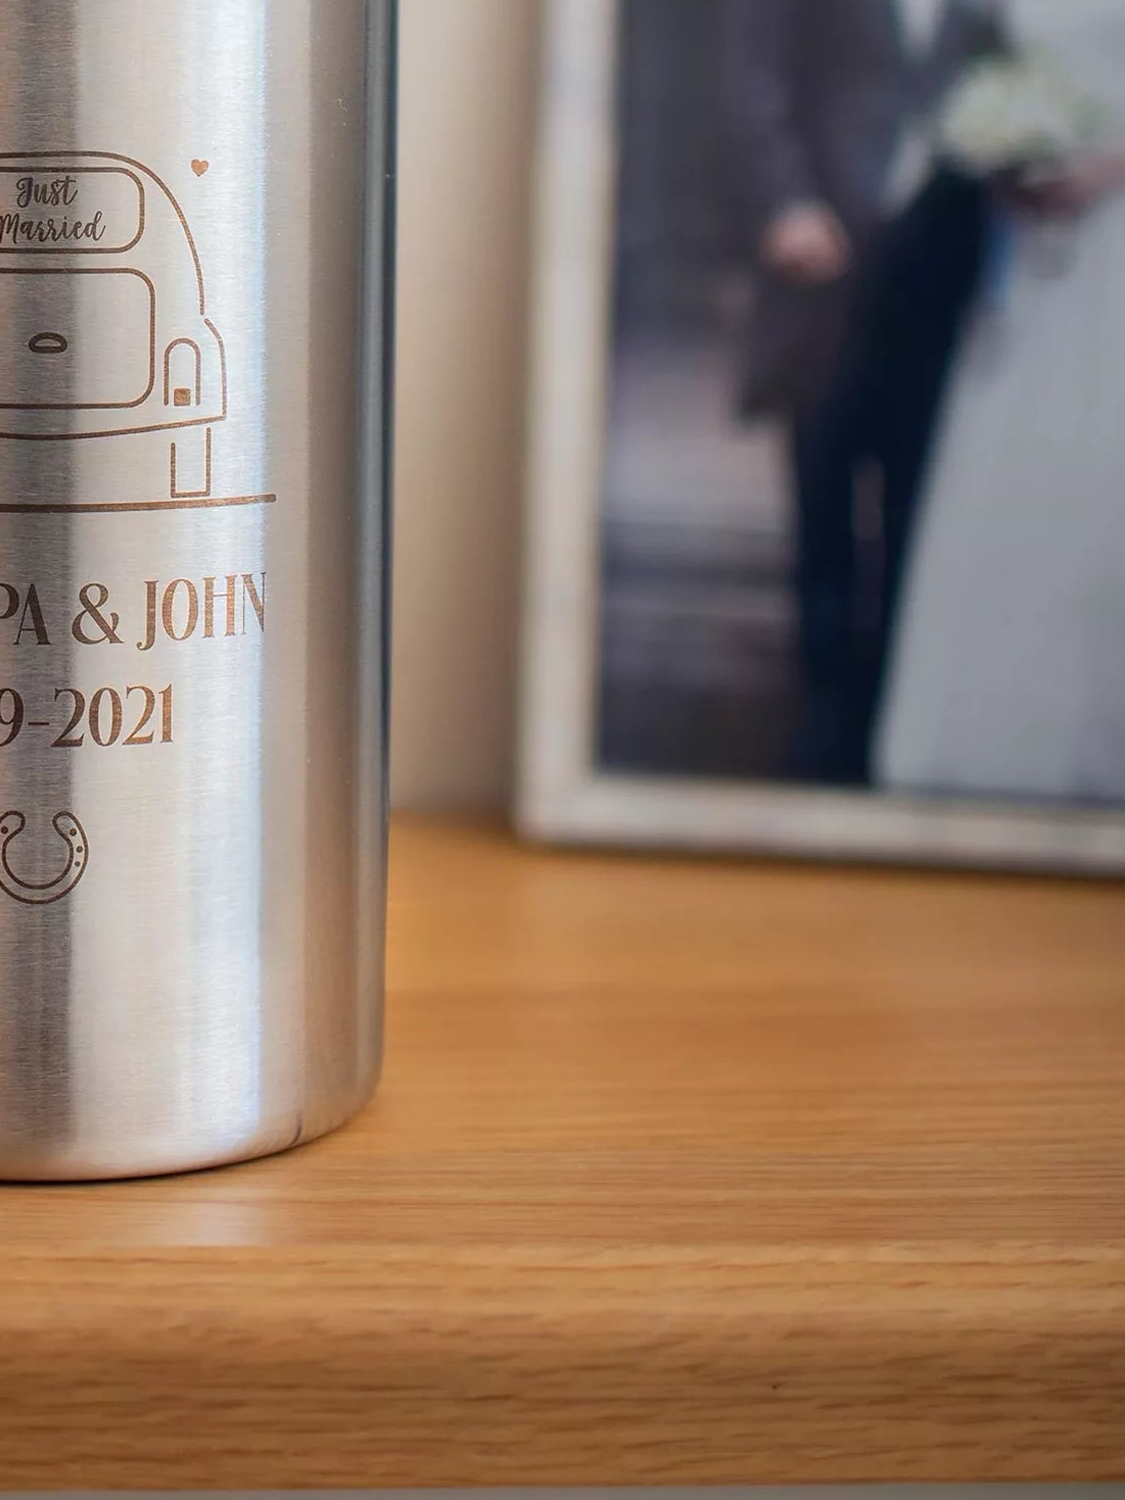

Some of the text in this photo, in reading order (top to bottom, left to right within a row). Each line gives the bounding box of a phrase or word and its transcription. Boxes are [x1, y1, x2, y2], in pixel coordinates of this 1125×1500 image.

[16, 175, 78, 208] Just
[71, 582, 125, 645] &
[136, 571, 268, 652] JOHN
